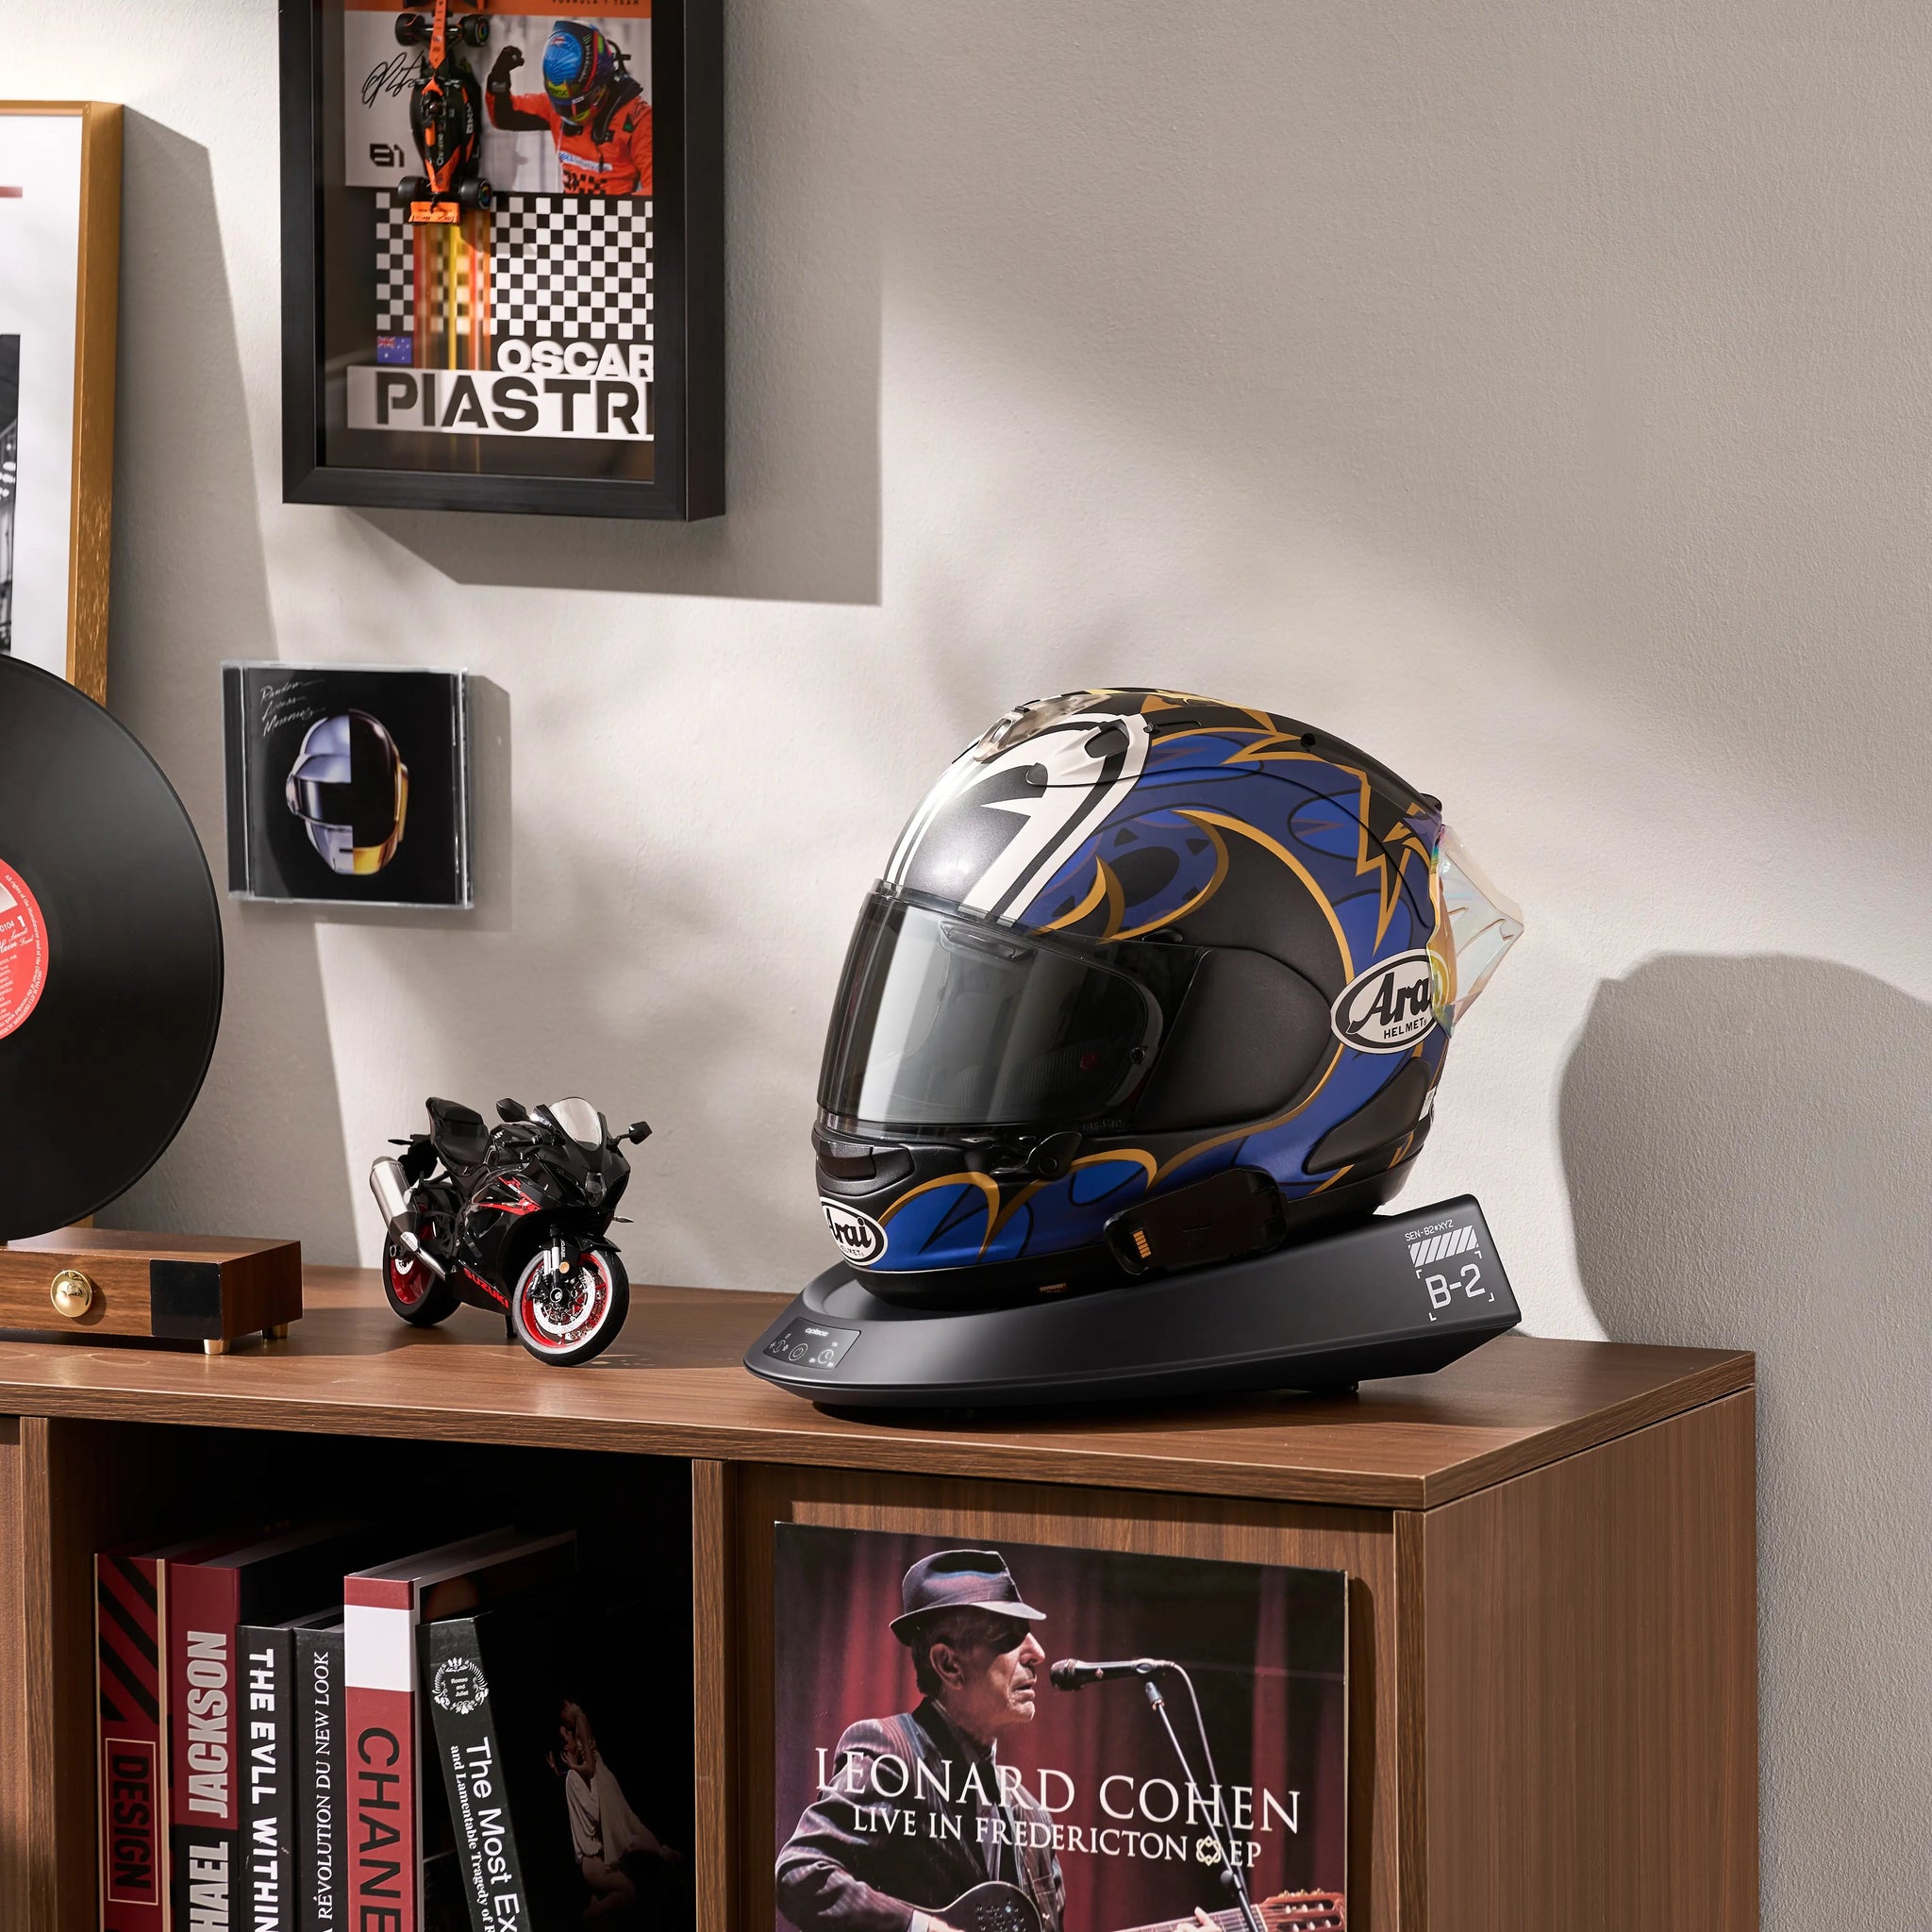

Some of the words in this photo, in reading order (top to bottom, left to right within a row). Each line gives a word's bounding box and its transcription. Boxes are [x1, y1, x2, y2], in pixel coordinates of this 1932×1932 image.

[496, 338, 654, 379] OSCAR
[1346, 972, 1432, 1034] Ara
[1383, 1016, 1424, 1040] HELMET
[463, 1267, 509, 1308] SUZUKI
[1424, 1263, 1486, 1309] B-2
[249, 1648, 275, 1711] THE
[313, 1651, 329, 1707] LOOK
[186, 1630, 229, 1819] JACKSON
[315, 1710, 330, 1756] NEW
[316, 1758, 331, 1790] DU
[450, 1745, 465, 1771] and
[466, 1736, 492, 1799] The
[456, 1772, 478, 1850] Lamentable
[814, 1746, 1076, 1814] LEONARD
[1099, 1774, 1301, 1835] COHEN
[111, 1754, 151, 1890] DESIGN
[358, 1726, 402, 1932] CHANE
[477, 1807, 513, 1885] Most
[853, 1805, 917, 1837] LIVE
[928, 1813, 962, 1840] IN
[975, 1817, 1188, 1864] FREDERICTON
[1229, 1840, 1262, 1869] EP
[252, 1817, 279, 1932] WITHIN
[313, 1794, 333, 1921] RÉVOLUTION
[471, 1851, 490, 1906] Tragedy
[481, 1908, 493, 1923] of
[493, 1893, 520, 1932] Ex
